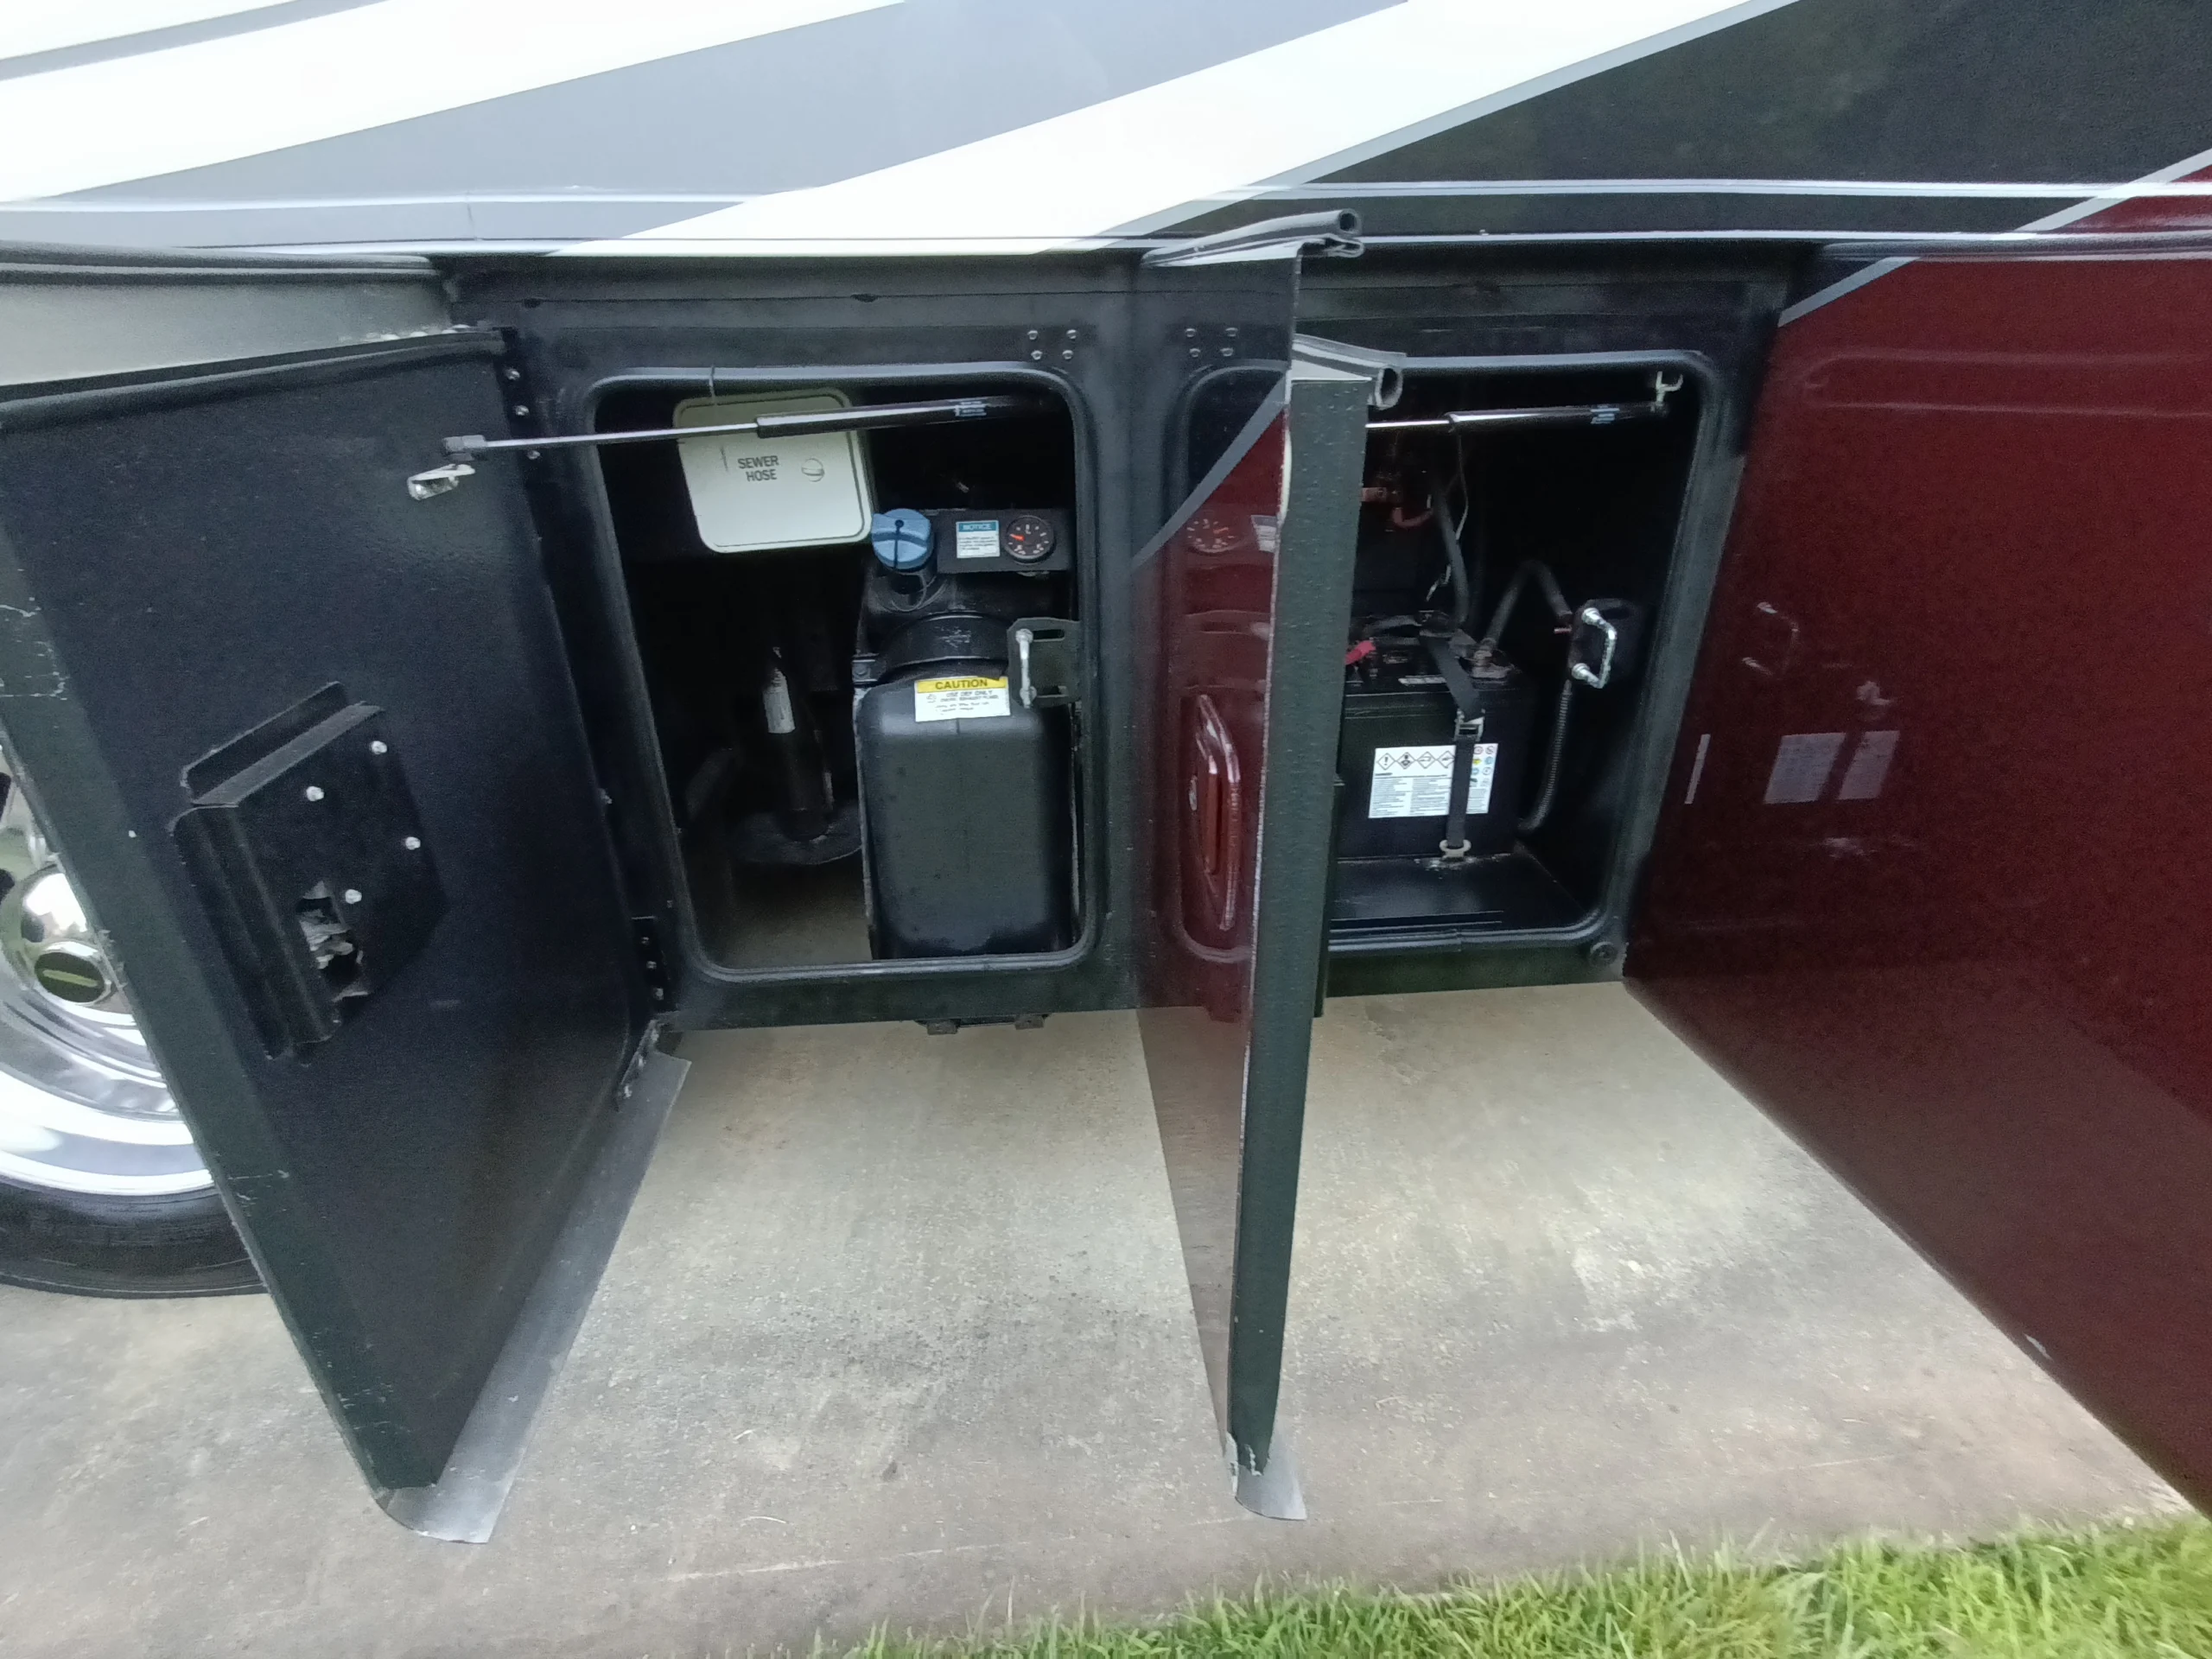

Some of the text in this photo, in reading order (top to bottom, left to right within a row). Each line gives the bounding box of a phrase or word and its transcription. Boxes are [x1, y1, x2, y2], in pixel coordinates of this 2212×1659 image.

[737, 455, 779, 469] SEWER
[745, 468, 778, 482] HOSE
[935, 679, 988, 690] CAUTION
